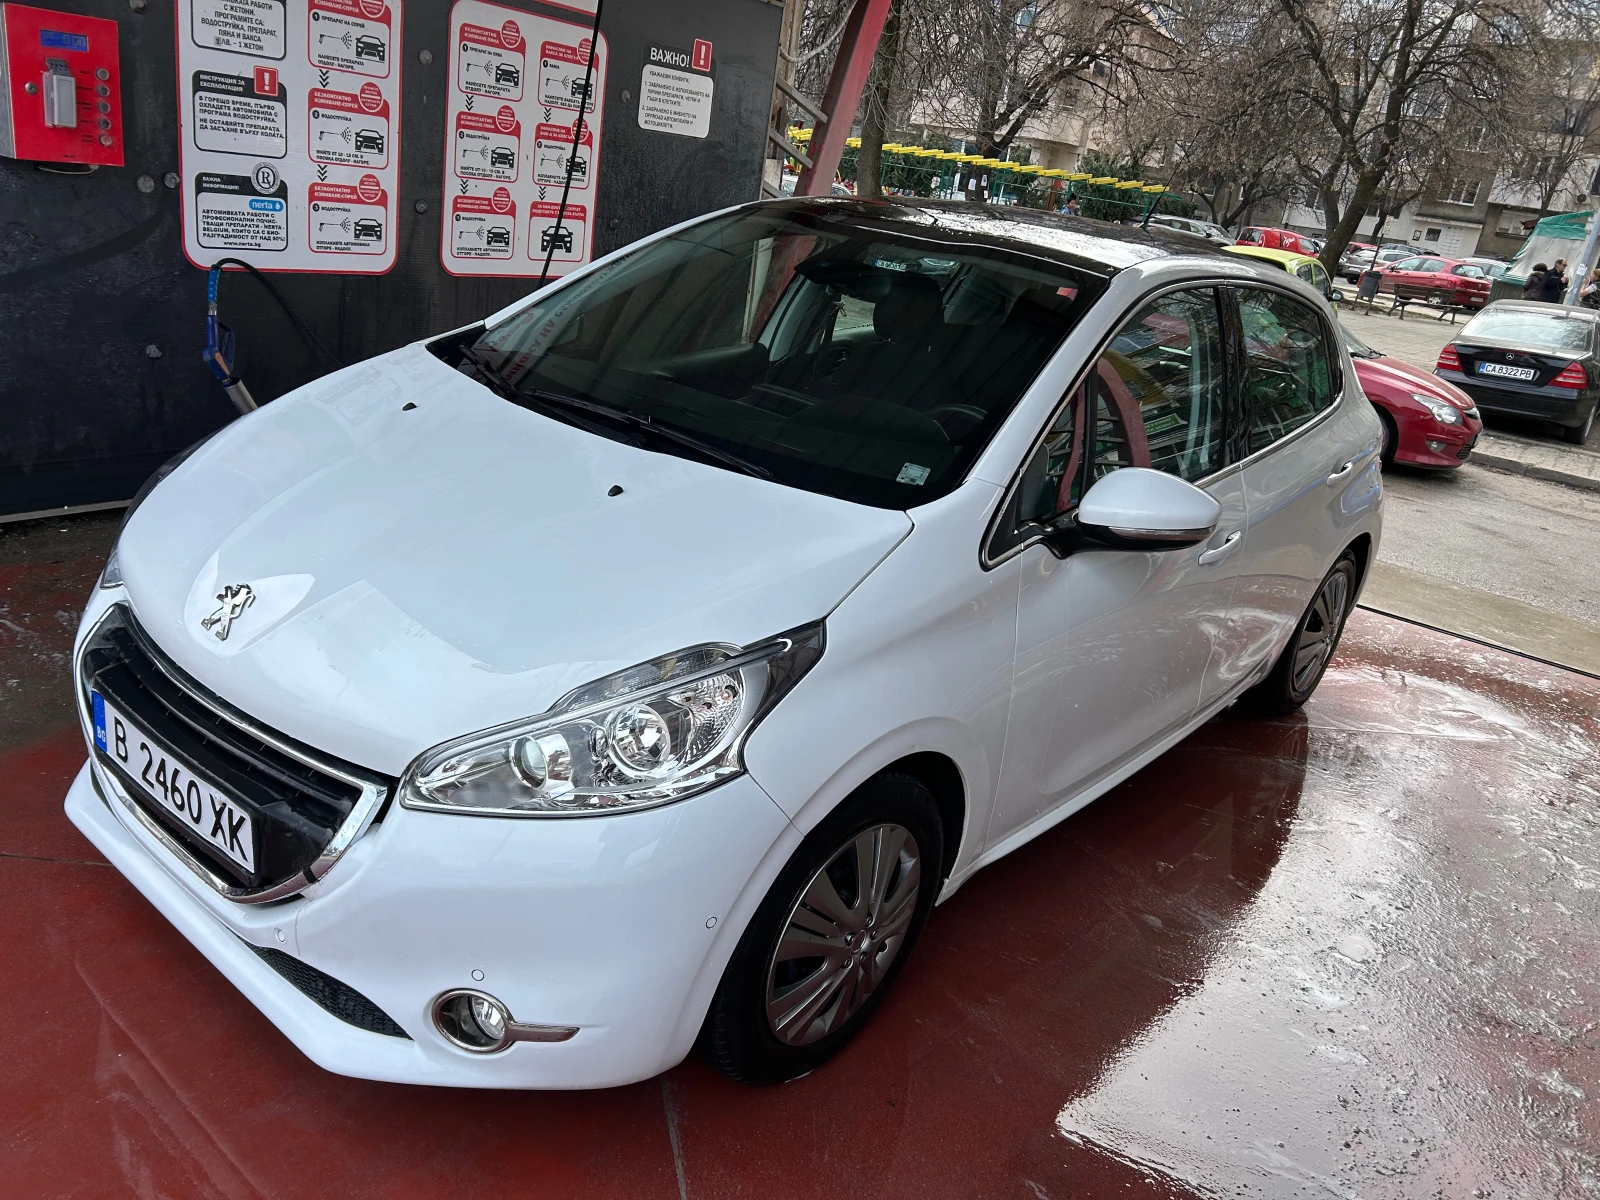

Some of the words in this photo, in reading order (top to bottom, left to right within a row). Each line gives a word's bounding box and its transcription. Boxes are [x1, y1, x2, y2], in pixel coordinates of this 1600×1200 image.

[229, 4, 255, 15] ЖЕТОНИ.
[250, 1, 272, 10] РАБОТИ
[215, 11, 254, 24] ПРОГРАМИТЕ
[255, 18, 264, 26] СА:
[322, 16, 343, 24] ПРЕПАРАТ
[201, 18, 245, 31] ВОДОСТРУЙКА,
[247, 26, 277, 37] ПРЕПАРАТ,
[219, 29, 235, 38] ПЯНА
[242, 34, 261, 42] ВАКСА
[243, 42, 263, 51] ЖЕТОН
[341, 57, 364, 66] ПРЕПАРАТА
[650, 47, 689, 67] ВАЖНО!
[200, 74, 237, 84] ИНСТРУКЦИЯ
[649, 71, 671, 80] УВАЖАЕМИ
[200, 81, 243, 92] ЕКСПЛОАТАЦИЯ
[649, 82, 671, 91] ЗАБРАНЕНО
[314, 92, 351, 101] БЕЗКОНТАКТНО
[205, 96, 229, 105] ГОРЕЩО
[232, 100, 252, 108] ВРЕМЕ,
[199, 102, 230, 111] ОХЛАДЕТЕ
[233, 107, 272, 116] АВТОМОБИЛА
[199, 109, 231, 117] ПРОГРАМА
[646, 106, 669, 114] ЗАБРАНЕНО
[209, 119, 244, 128] ОСТАВЯЙТЕ
[246, 124, 279, 132] ПРЕПАРАТА
[210, 125, 238, 133] ЗАСЪХНЕ
[202, 209, 245, 217] АВТОМИВКАТА
[202, 215, 254, 223] ПРОФЕСИОНАЛНИ
[1485, 365, 1496, 373] CA
[1498, 366, 1519, 376] 8322
[1520, 369, 1531, 378] PB
[97, 725, 106, 742] BG
[114, 715, 128, 763] B
[140, 741, 202, 825] 2460
[209, 792, 249, 862] XK
